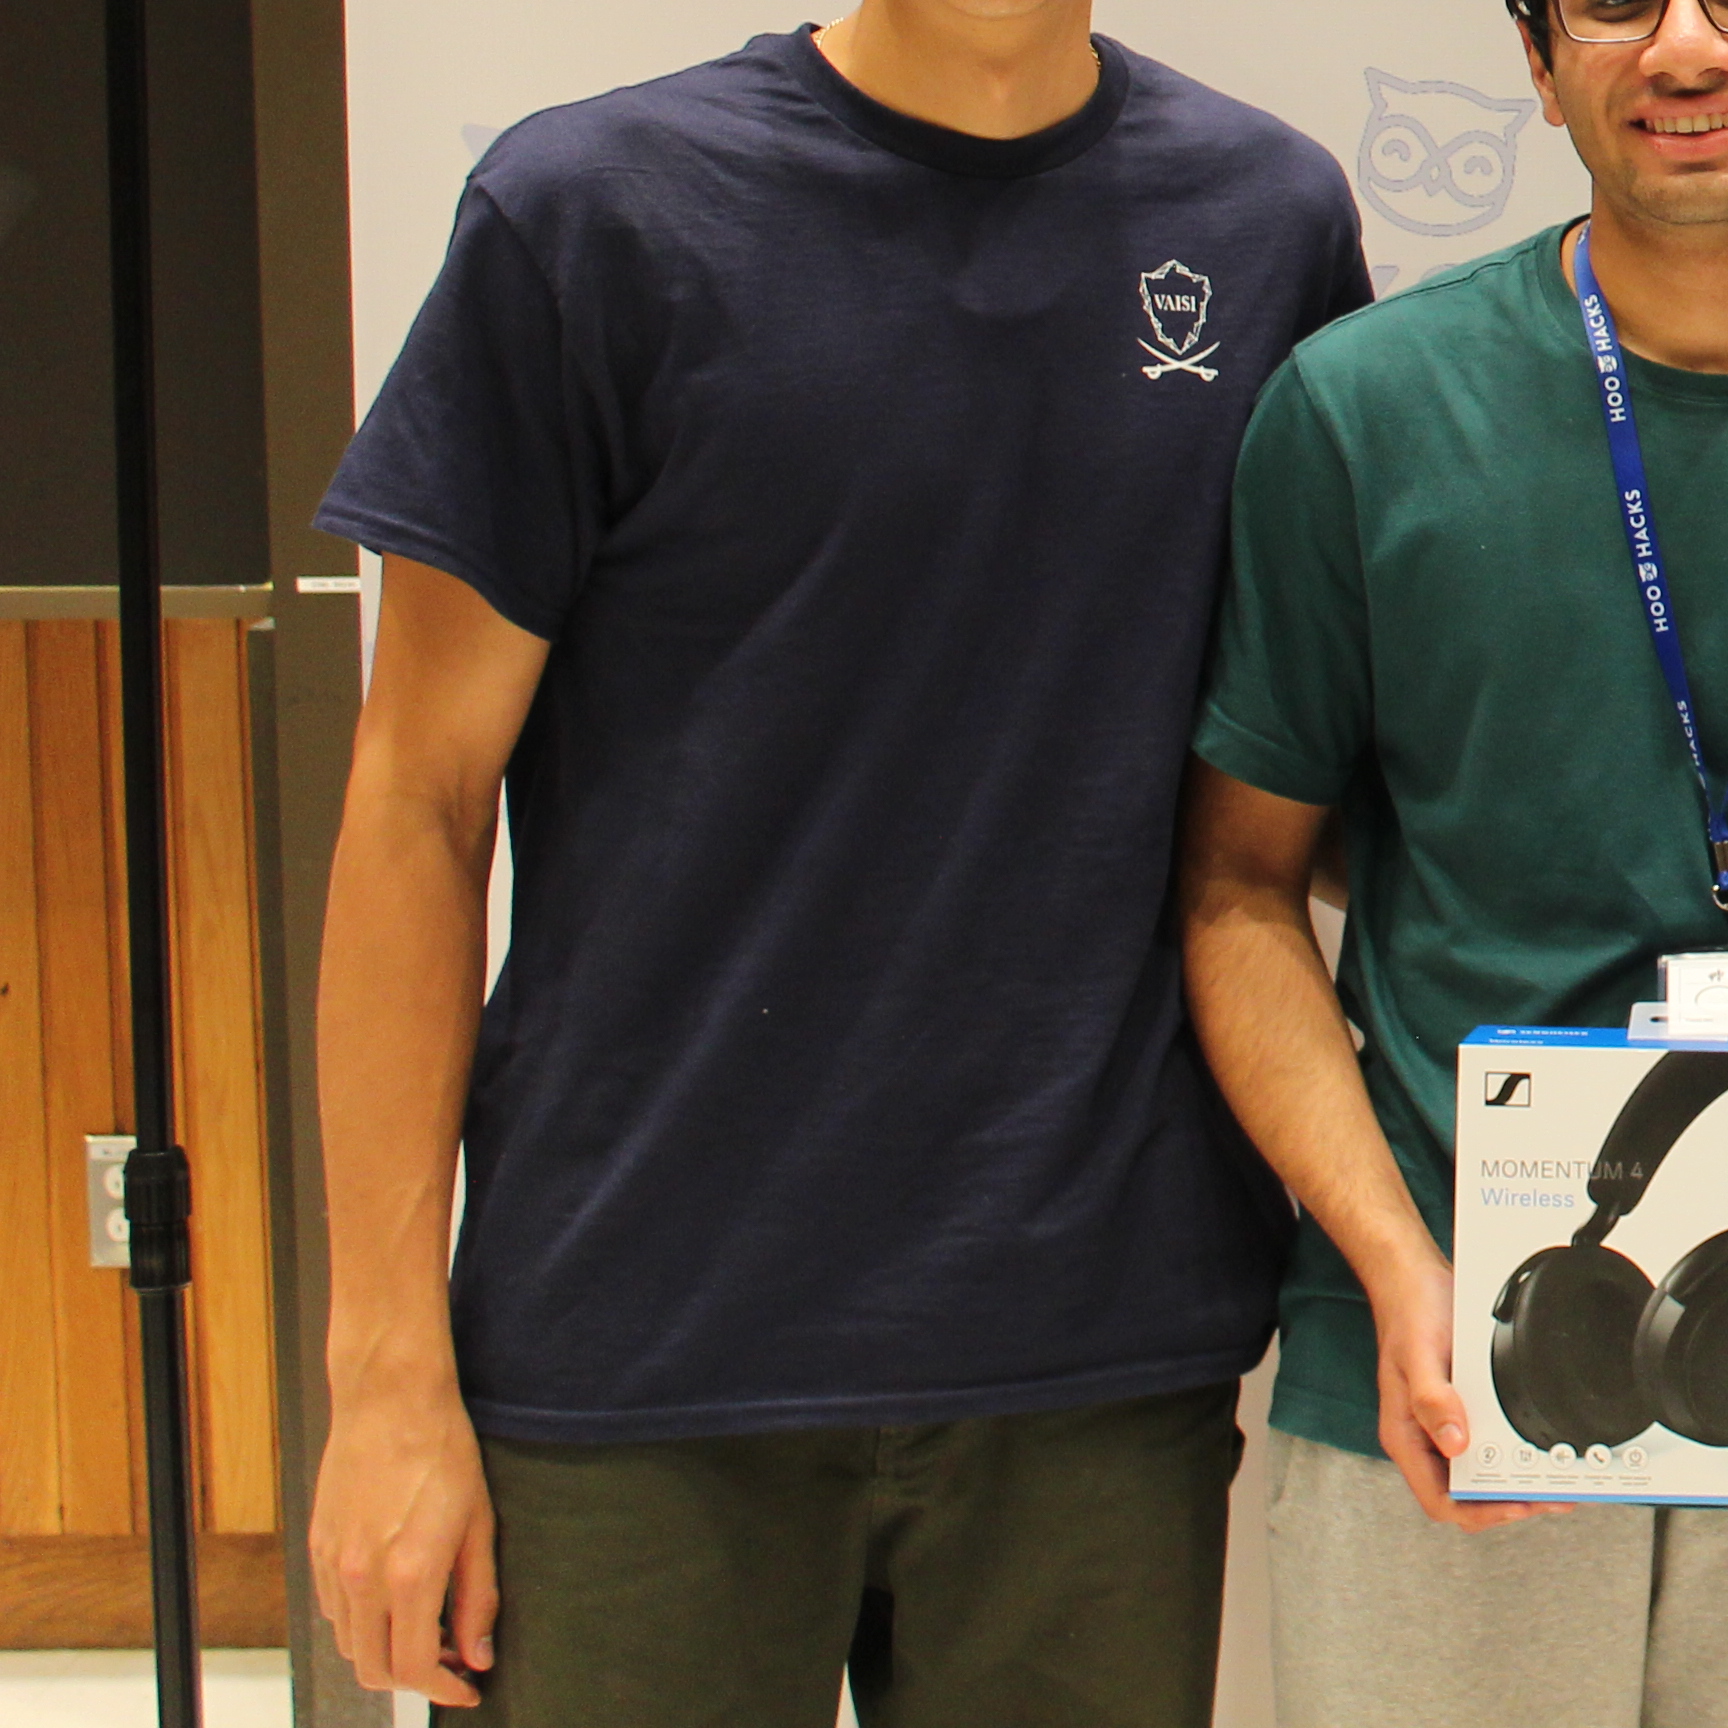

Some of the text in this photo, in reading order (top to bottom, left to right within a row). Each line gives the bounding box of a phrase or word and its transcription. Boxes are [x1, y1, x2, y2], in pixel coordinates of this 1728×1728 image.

[1153, 293, 1198, 312] VAISI
[1584, 293, 1626, 422] HOO HACKS
[1624, 489, 1669, 632] HOO HACKS
[1481, 1159, 1644, 1180] MOMENTUM 4
[1481, 1187, 1575, 1209] Wireless
